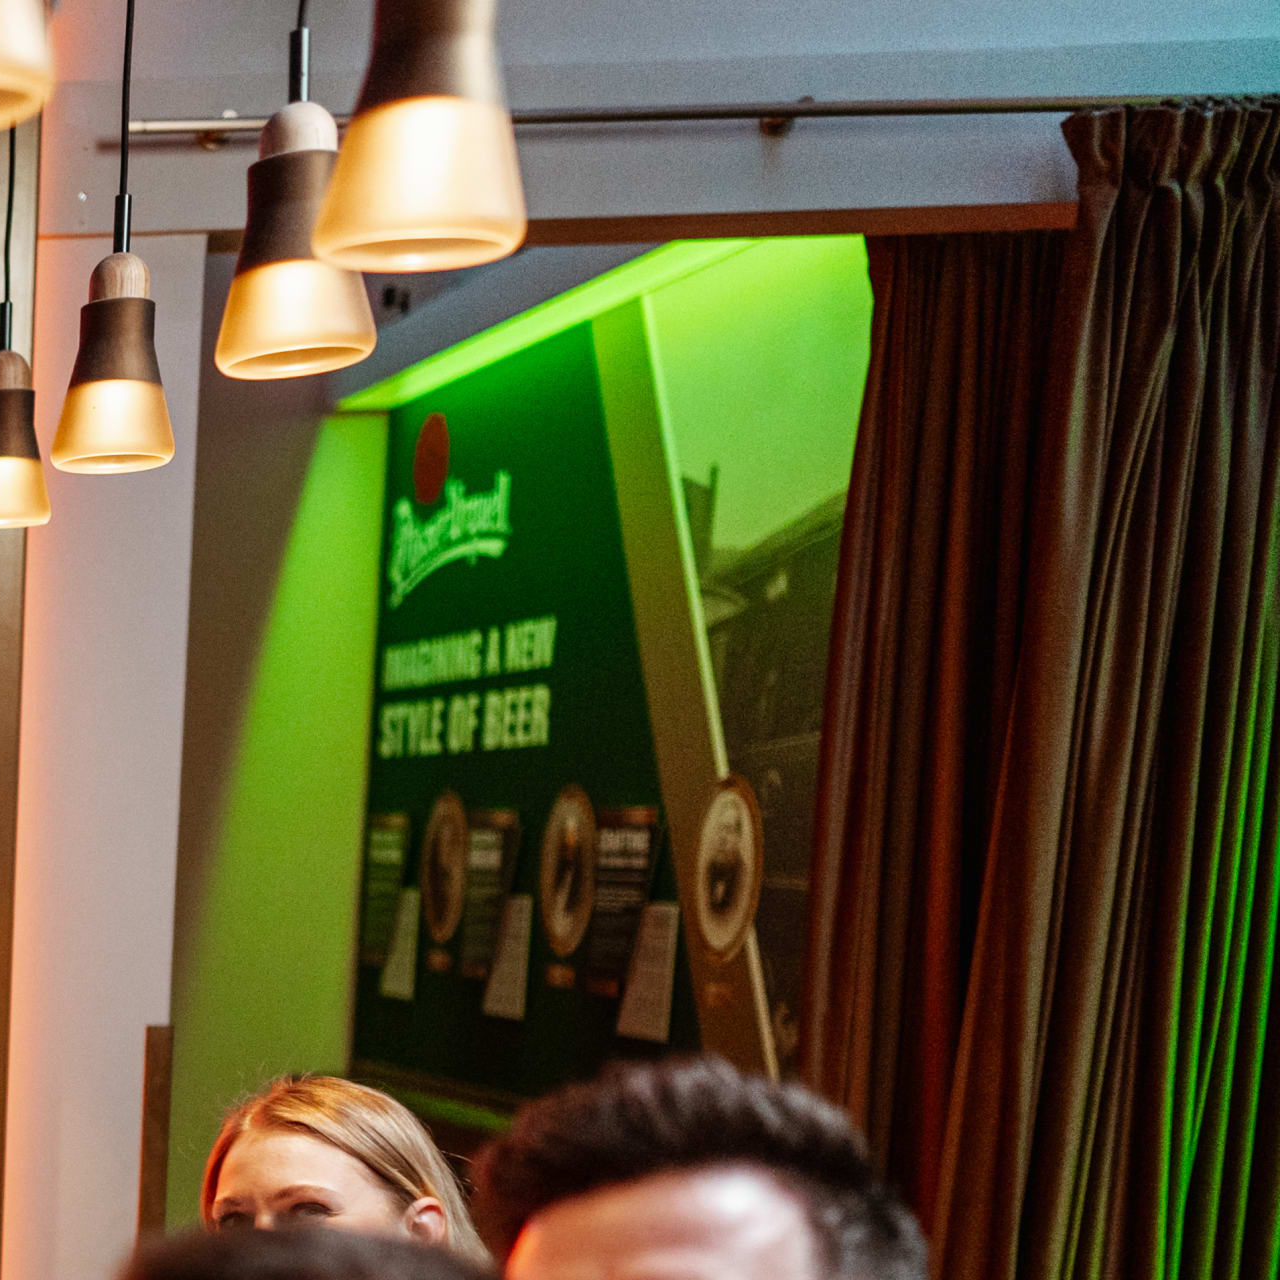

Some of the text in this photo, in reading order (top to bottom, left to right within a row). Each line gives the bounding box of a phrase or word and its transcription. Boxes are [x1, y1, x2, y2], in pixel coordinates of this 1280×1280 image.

[379, 683, 550, 759] STYLE OF BEER
